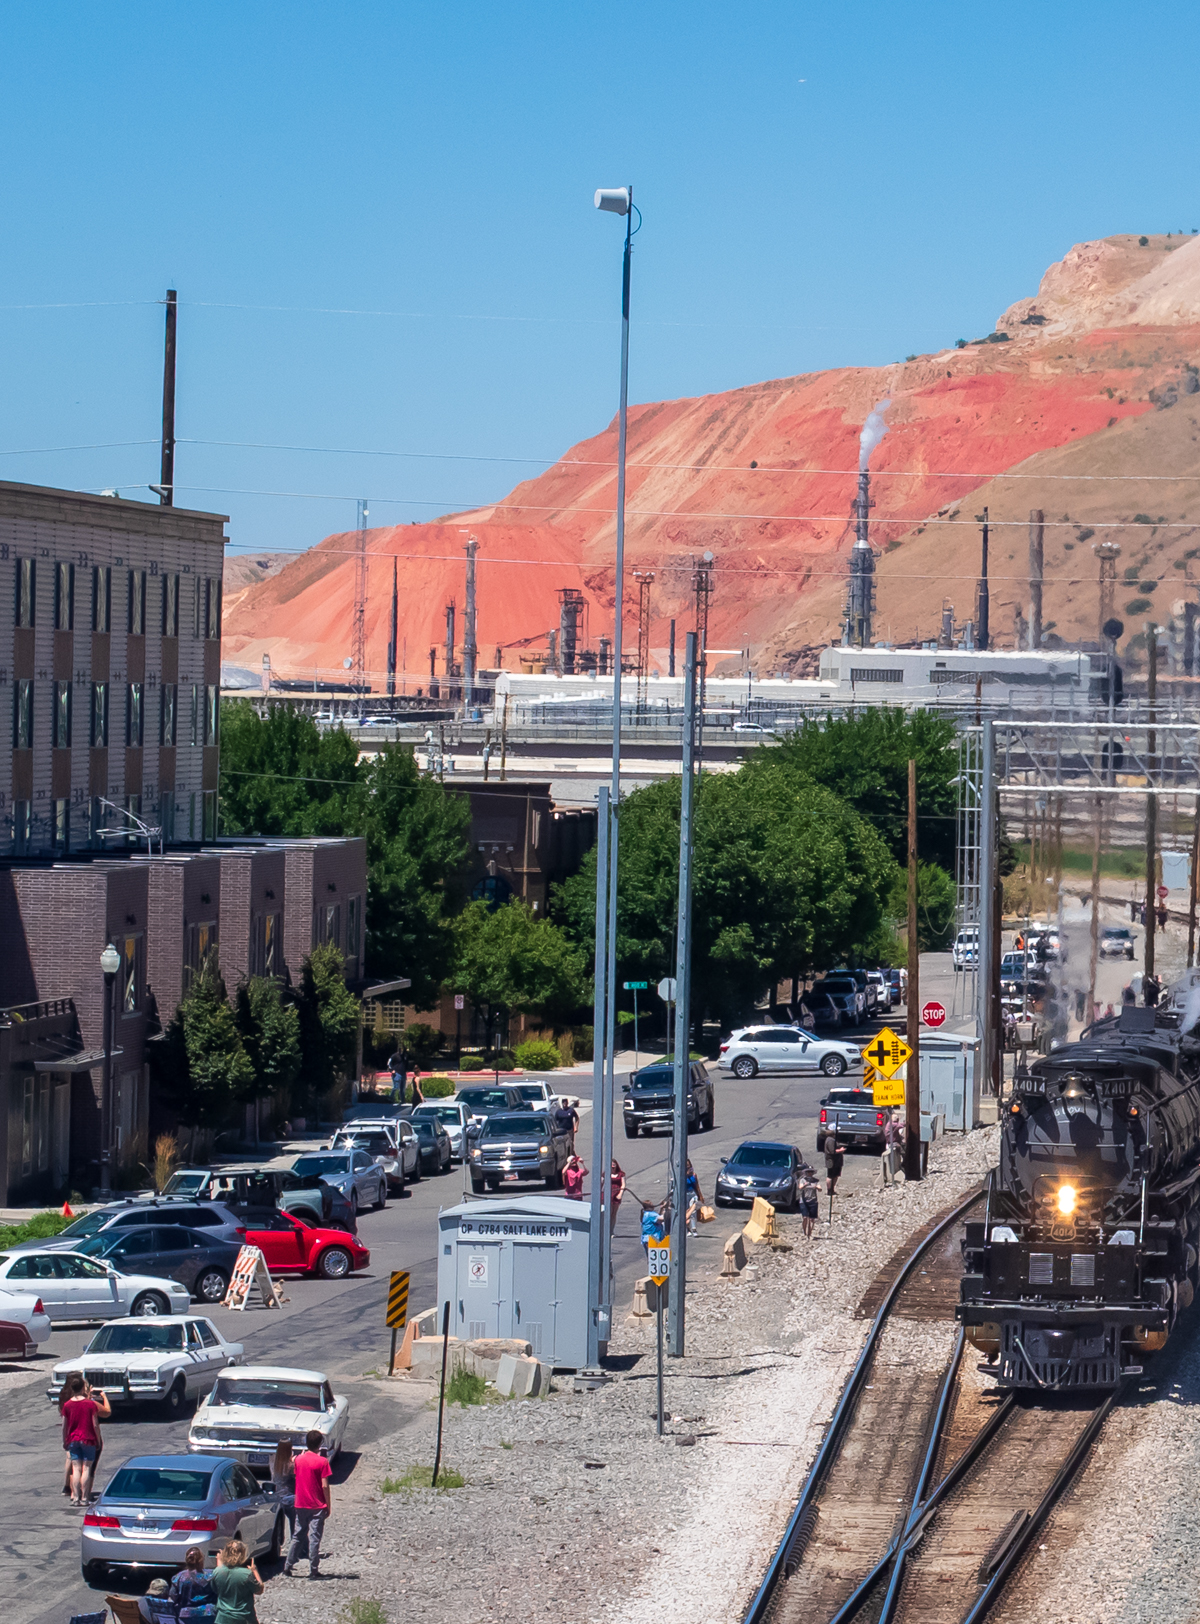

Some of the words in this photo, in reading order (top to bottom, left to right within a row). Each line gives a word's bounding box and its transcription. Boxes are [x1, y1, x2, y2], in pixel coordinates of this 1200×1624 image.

[923, 1010, 945, 1020] STOP
[1013, 1079, 1046, 1093] X4014
[1104, 1080, 1141, 1095] X4014
[461, 1223, 473, 1234] CP
[478, 1224, 500, 1235] C784
[503, 1225, 524, 1236] SALT
[526, 1225, 547, 1236] LAKE
[550, 1226, 569, 1237] CITY
[1053, 1228, 1074, 1237] 4014
[650, 1249, 668, 1261] 30
[650, 1263, 668, 1275] 30
